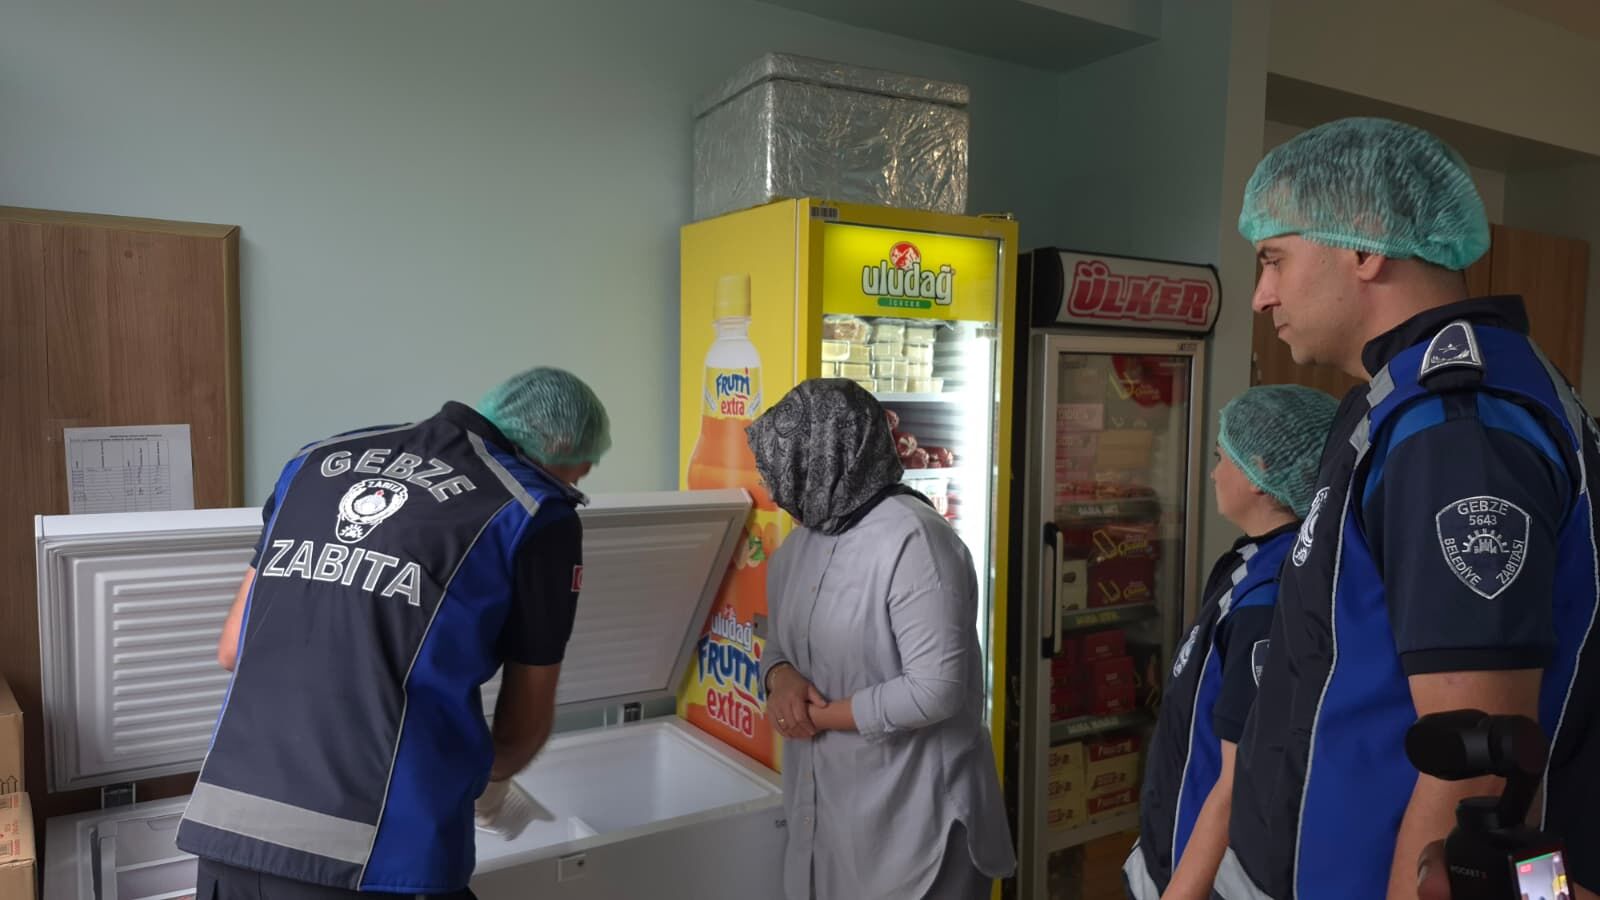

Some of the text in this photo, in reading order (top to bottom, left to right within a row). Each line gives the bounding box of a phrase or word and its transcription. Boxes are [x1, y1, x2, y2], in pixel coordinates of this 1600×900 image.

[862, 260, 953, 305] uludağ
[1068, 260, 1212, 325] ÜLKER
[721, 398, 745, 415] extra
[320, 447, 477, 503] GEBZE
[367, 481, 402, 493] ZABITA
[1457, 500, 1509, 515] GEBZE
[1469, 514, 1497, 526] 5643
[262, 539, 423, 607] ZABITA
[1444, 537, 1482, 586] BELEDİYE
[1495, 540, 1525, 585] ZABITASI
[711, 613, 753, 651] uludağ
[706, 688, 753, 737] extra
